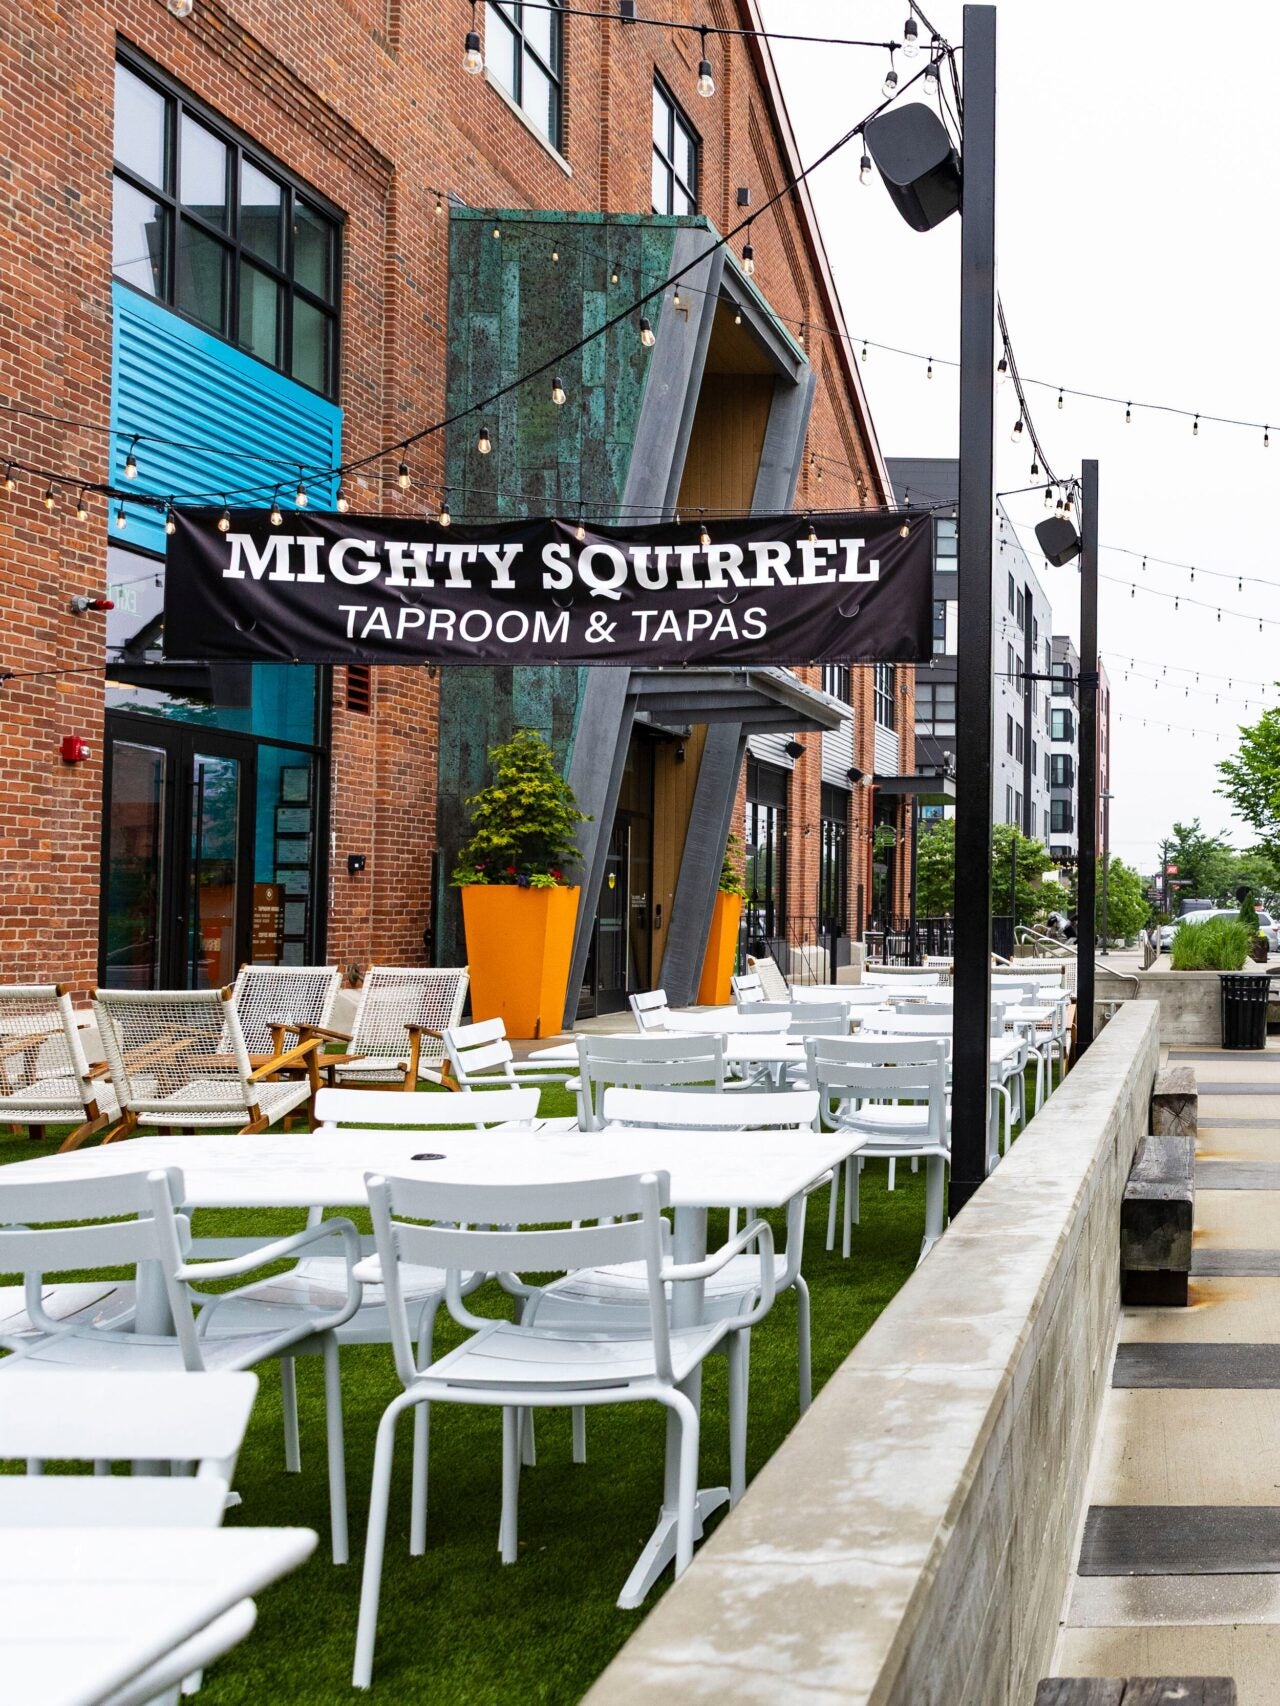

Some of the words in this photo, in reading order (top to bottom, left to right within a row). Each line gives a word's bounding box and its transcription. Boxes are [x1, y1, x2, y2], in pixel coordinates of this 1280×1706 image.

[223, 534, 523, 588] MIGHTY
[542, 534, 879, 600] SQUIRREL
[338, 605, 569, 642] TAPROOM
[585, 611, 617, 643] &
[632, 607, 767, 641] TAPAS
